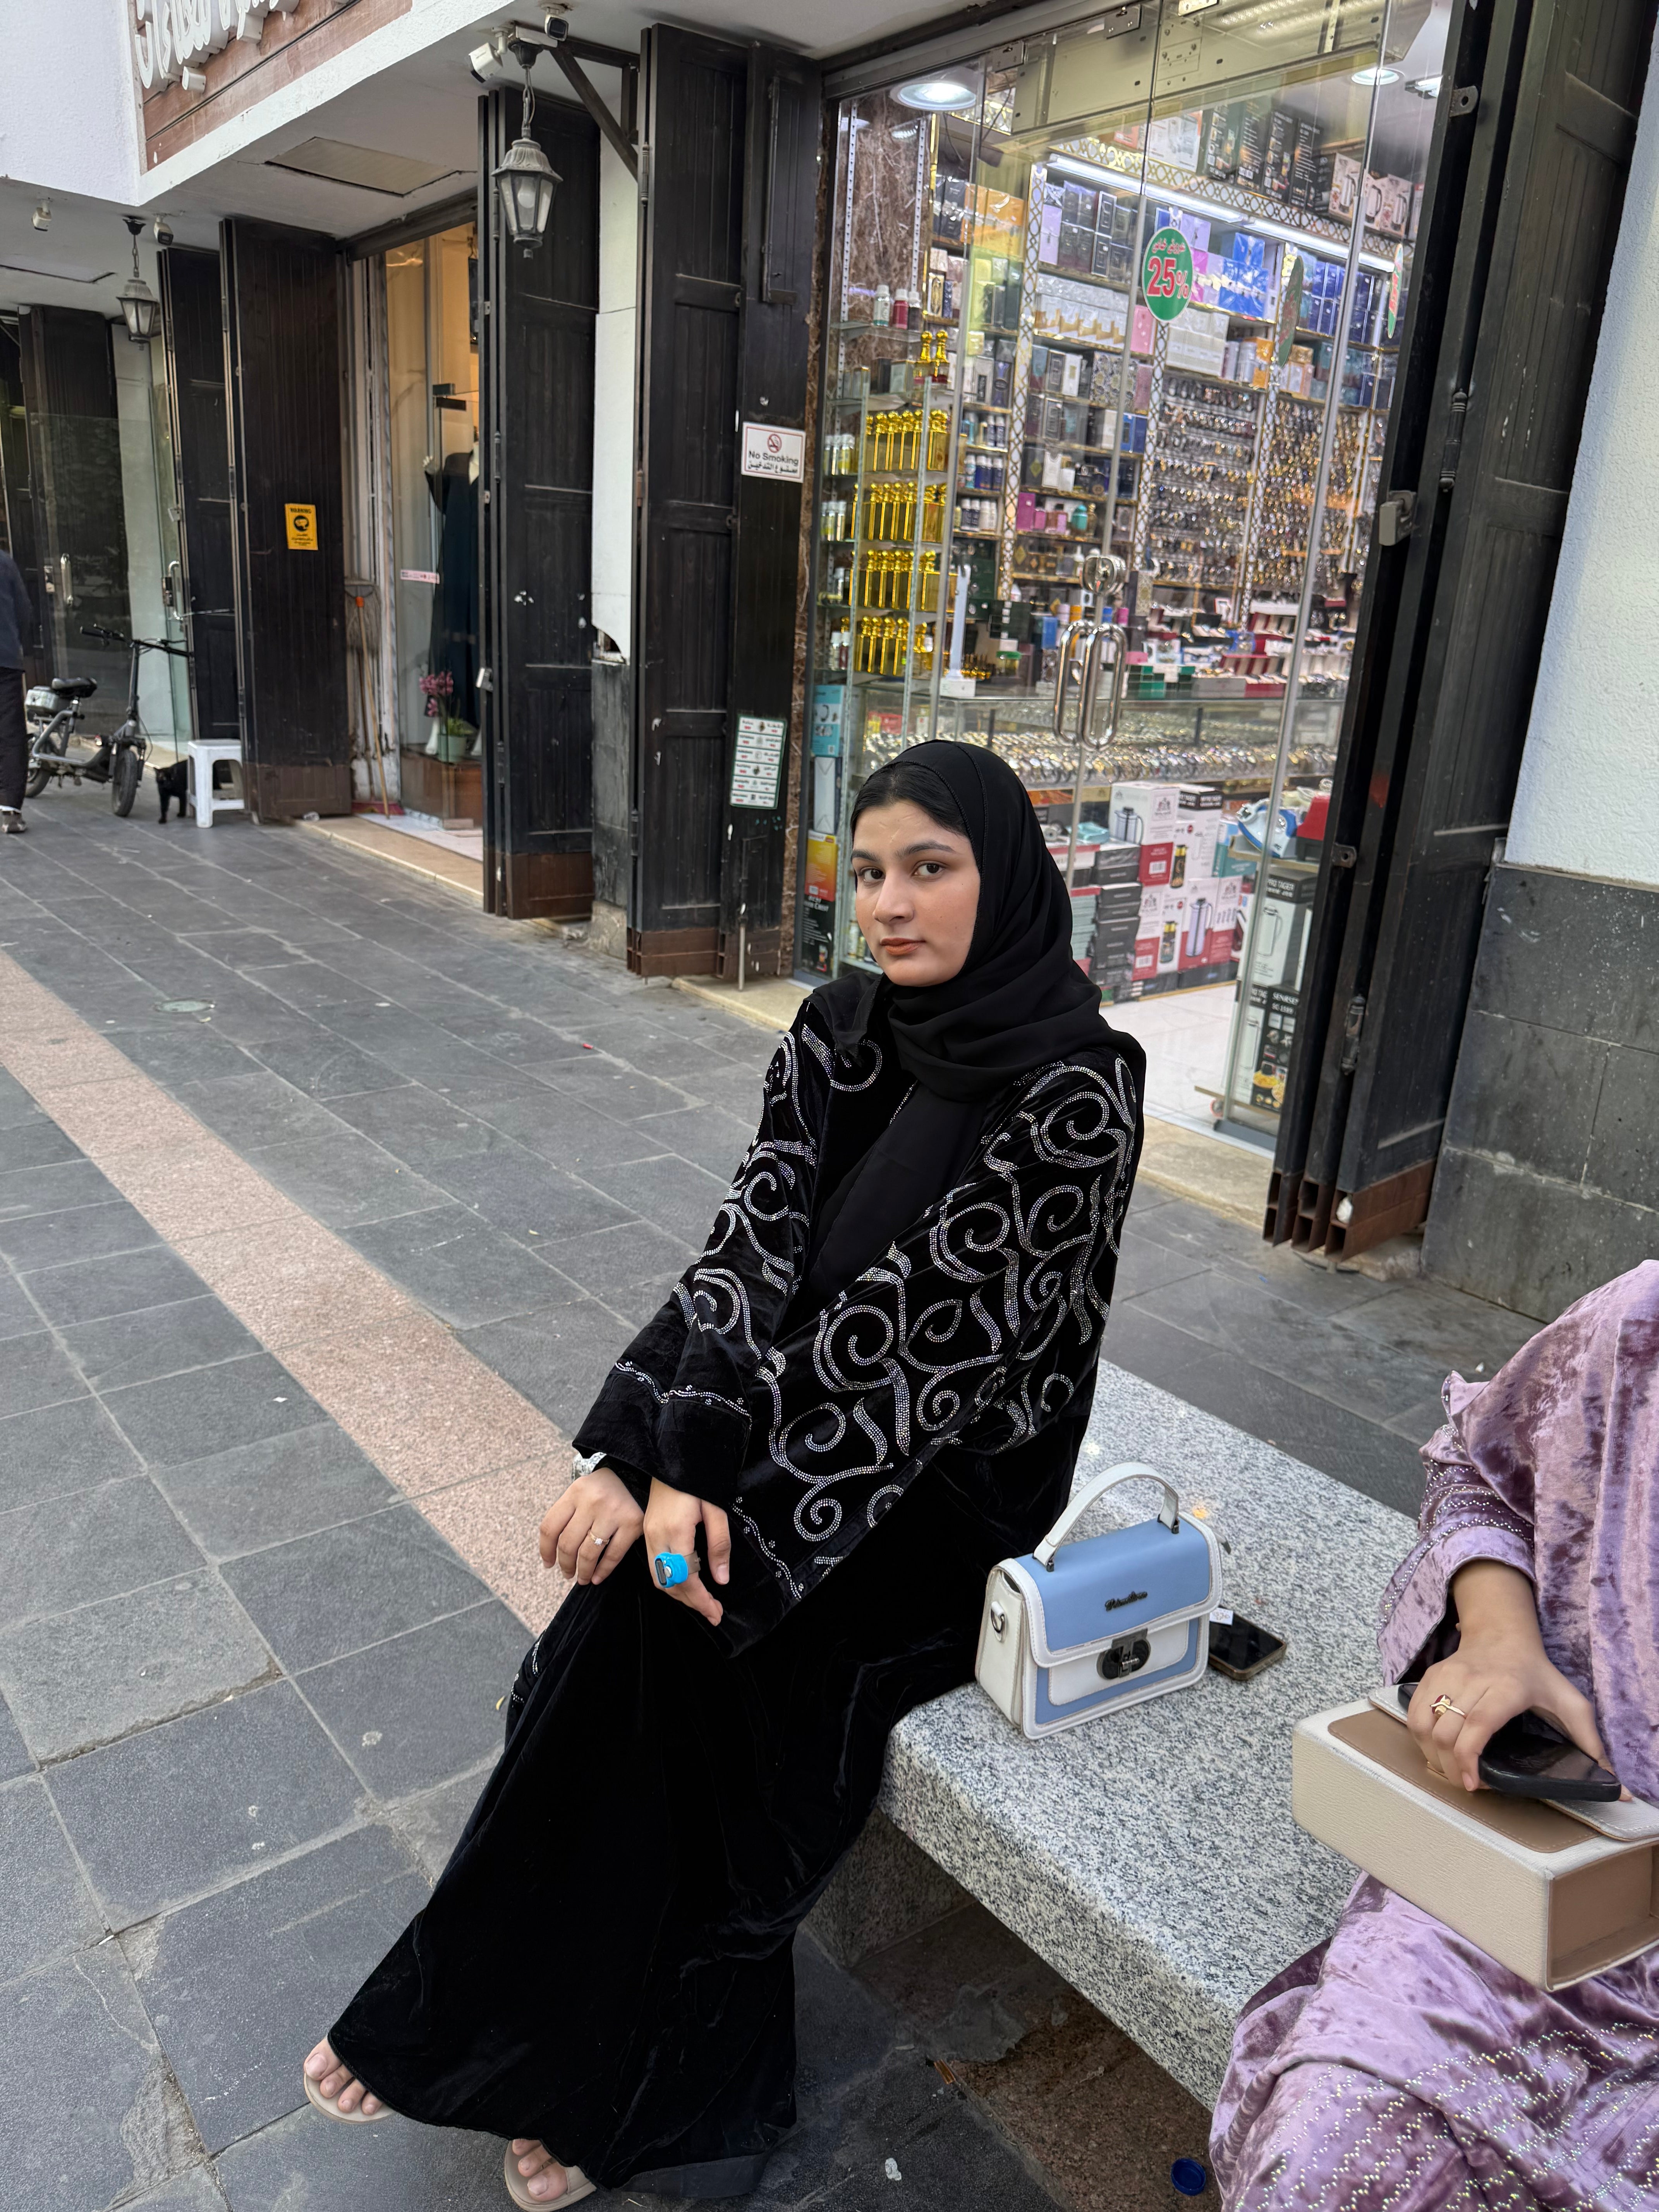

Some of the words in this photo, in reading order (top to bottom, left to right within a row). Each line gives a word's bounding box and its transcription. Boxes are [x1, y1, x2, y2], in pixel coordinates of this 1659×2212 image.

[1147, 256, 1188, 299] 25%
[748, 450, 760, 459] No
[763, 453, 799, 466] Smoking
